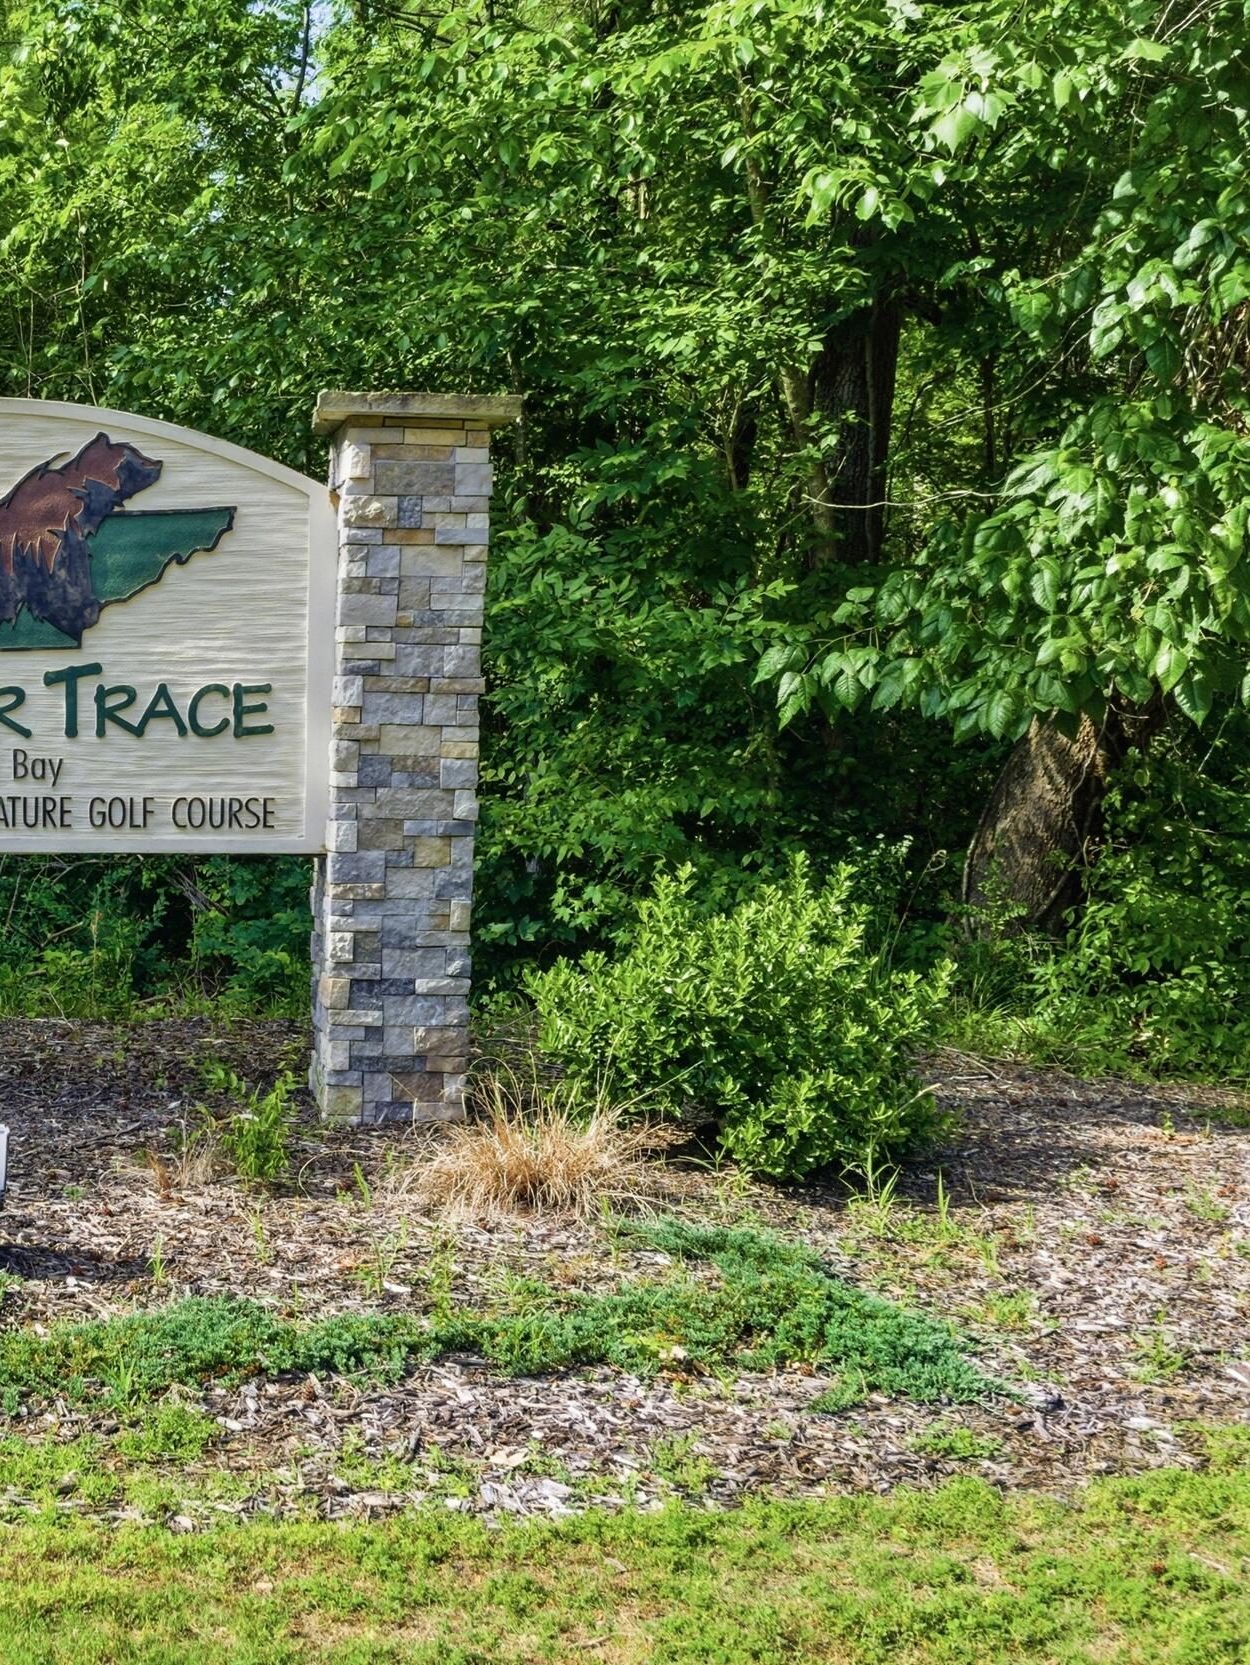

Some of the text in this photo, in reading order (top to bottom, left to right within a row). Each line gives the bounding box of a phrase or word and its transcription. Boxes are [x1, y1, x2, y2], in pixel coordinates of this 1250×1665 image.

[43, 662, 276, 739] TRACE
[13, 748, 63, 787] Bay
[88, 797, 155, 829] GOLF
[172, 797, 275, 829] COURSE
